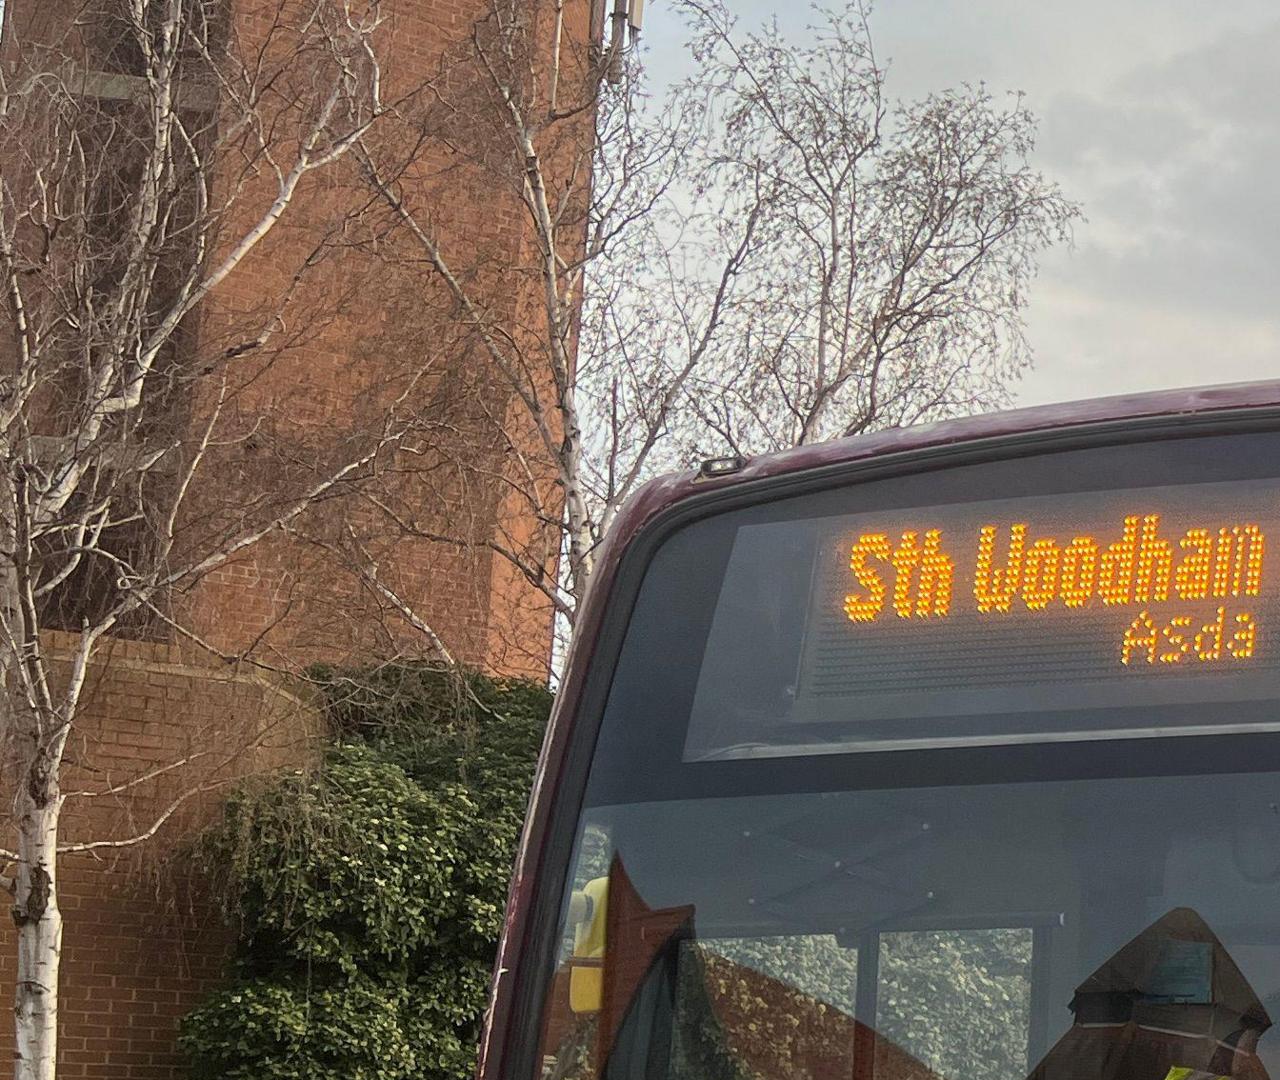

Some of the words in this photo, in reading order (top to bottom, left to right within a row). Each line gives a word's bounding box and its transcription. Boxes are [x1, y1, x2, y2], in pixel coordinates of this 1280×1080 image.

[843, 529, 954, 622] Sth
[972, 513, 1265, 614] Woodham
[1120, 605, 1256, 665] Asda
